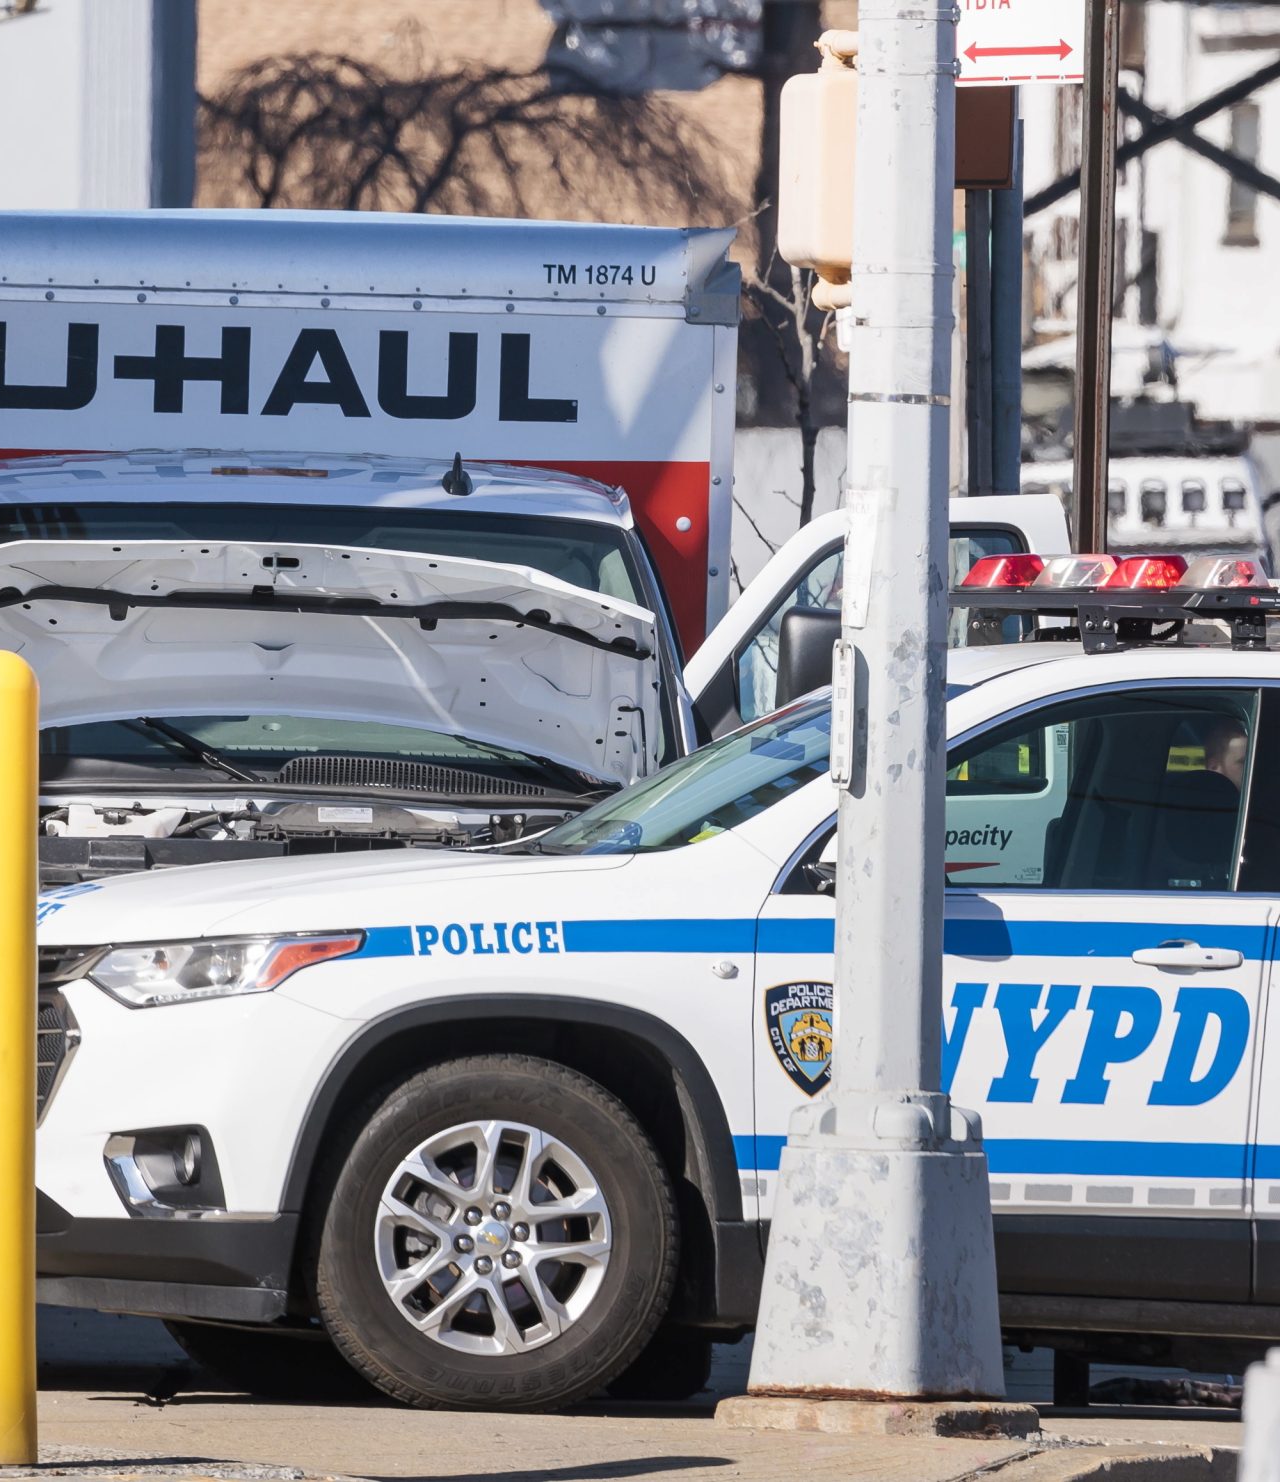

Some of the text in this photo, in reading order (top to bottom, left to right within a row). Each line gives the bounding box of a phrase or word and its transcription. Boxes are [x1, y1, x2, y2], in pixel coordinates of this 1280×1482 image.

[543, 264, 656, 286] TM 1874 U
[944, 823, 1014, 852] pacity
[415, 921, 561, 956] POLICE
[788, 983, 834, 998] POLICE
[770, 1026, 799, 1073] CITY OF
